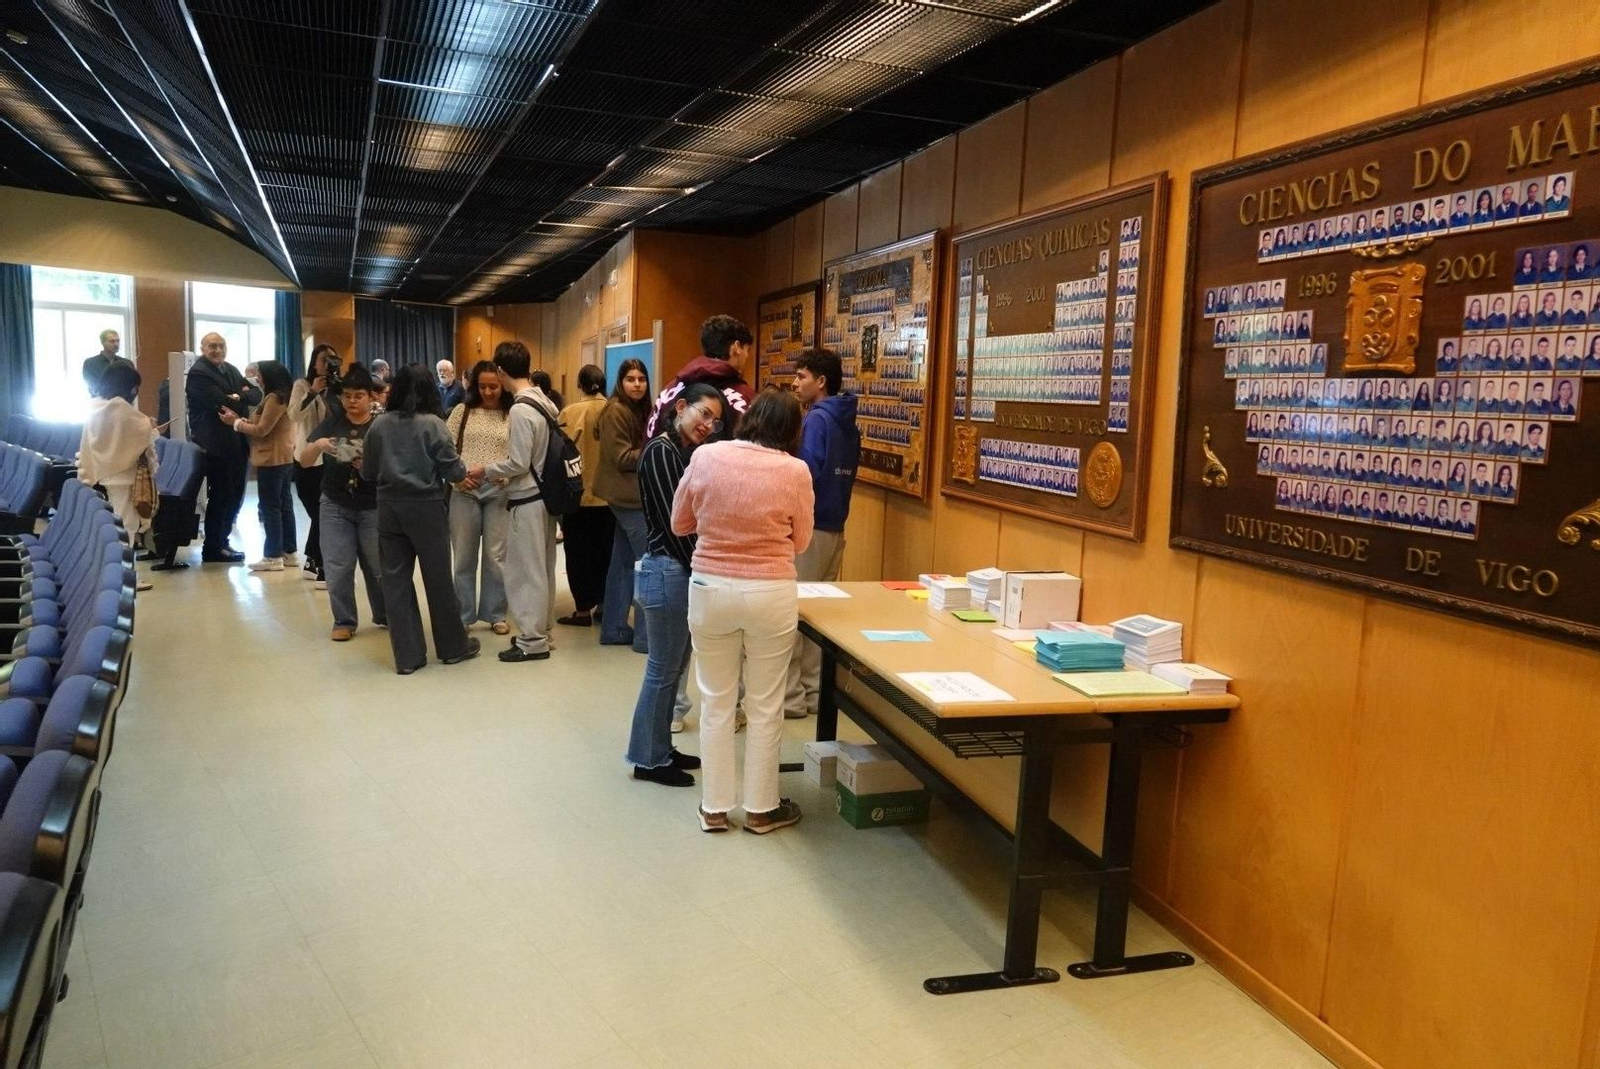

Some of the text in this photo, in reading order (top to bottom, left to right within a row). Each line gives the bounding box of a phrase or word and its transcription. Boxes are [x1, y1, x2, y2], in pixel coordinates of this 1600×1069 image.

[1239, 161, 1381, 226] CIENCIAS
[1413, 140, 1472, 191] DO
[976, 218, 1112, 270] CIENCIAS QUIMICAS
[1026, 285, 1047, 303] 2001
[1298, 250, 1497, 298] 1996 2001
[1225, 514, 1370, 562] UNIVERSIDADE
[1406, 547, 1442, 577] DE
[1476, 559, 1560, 597] VIGO
